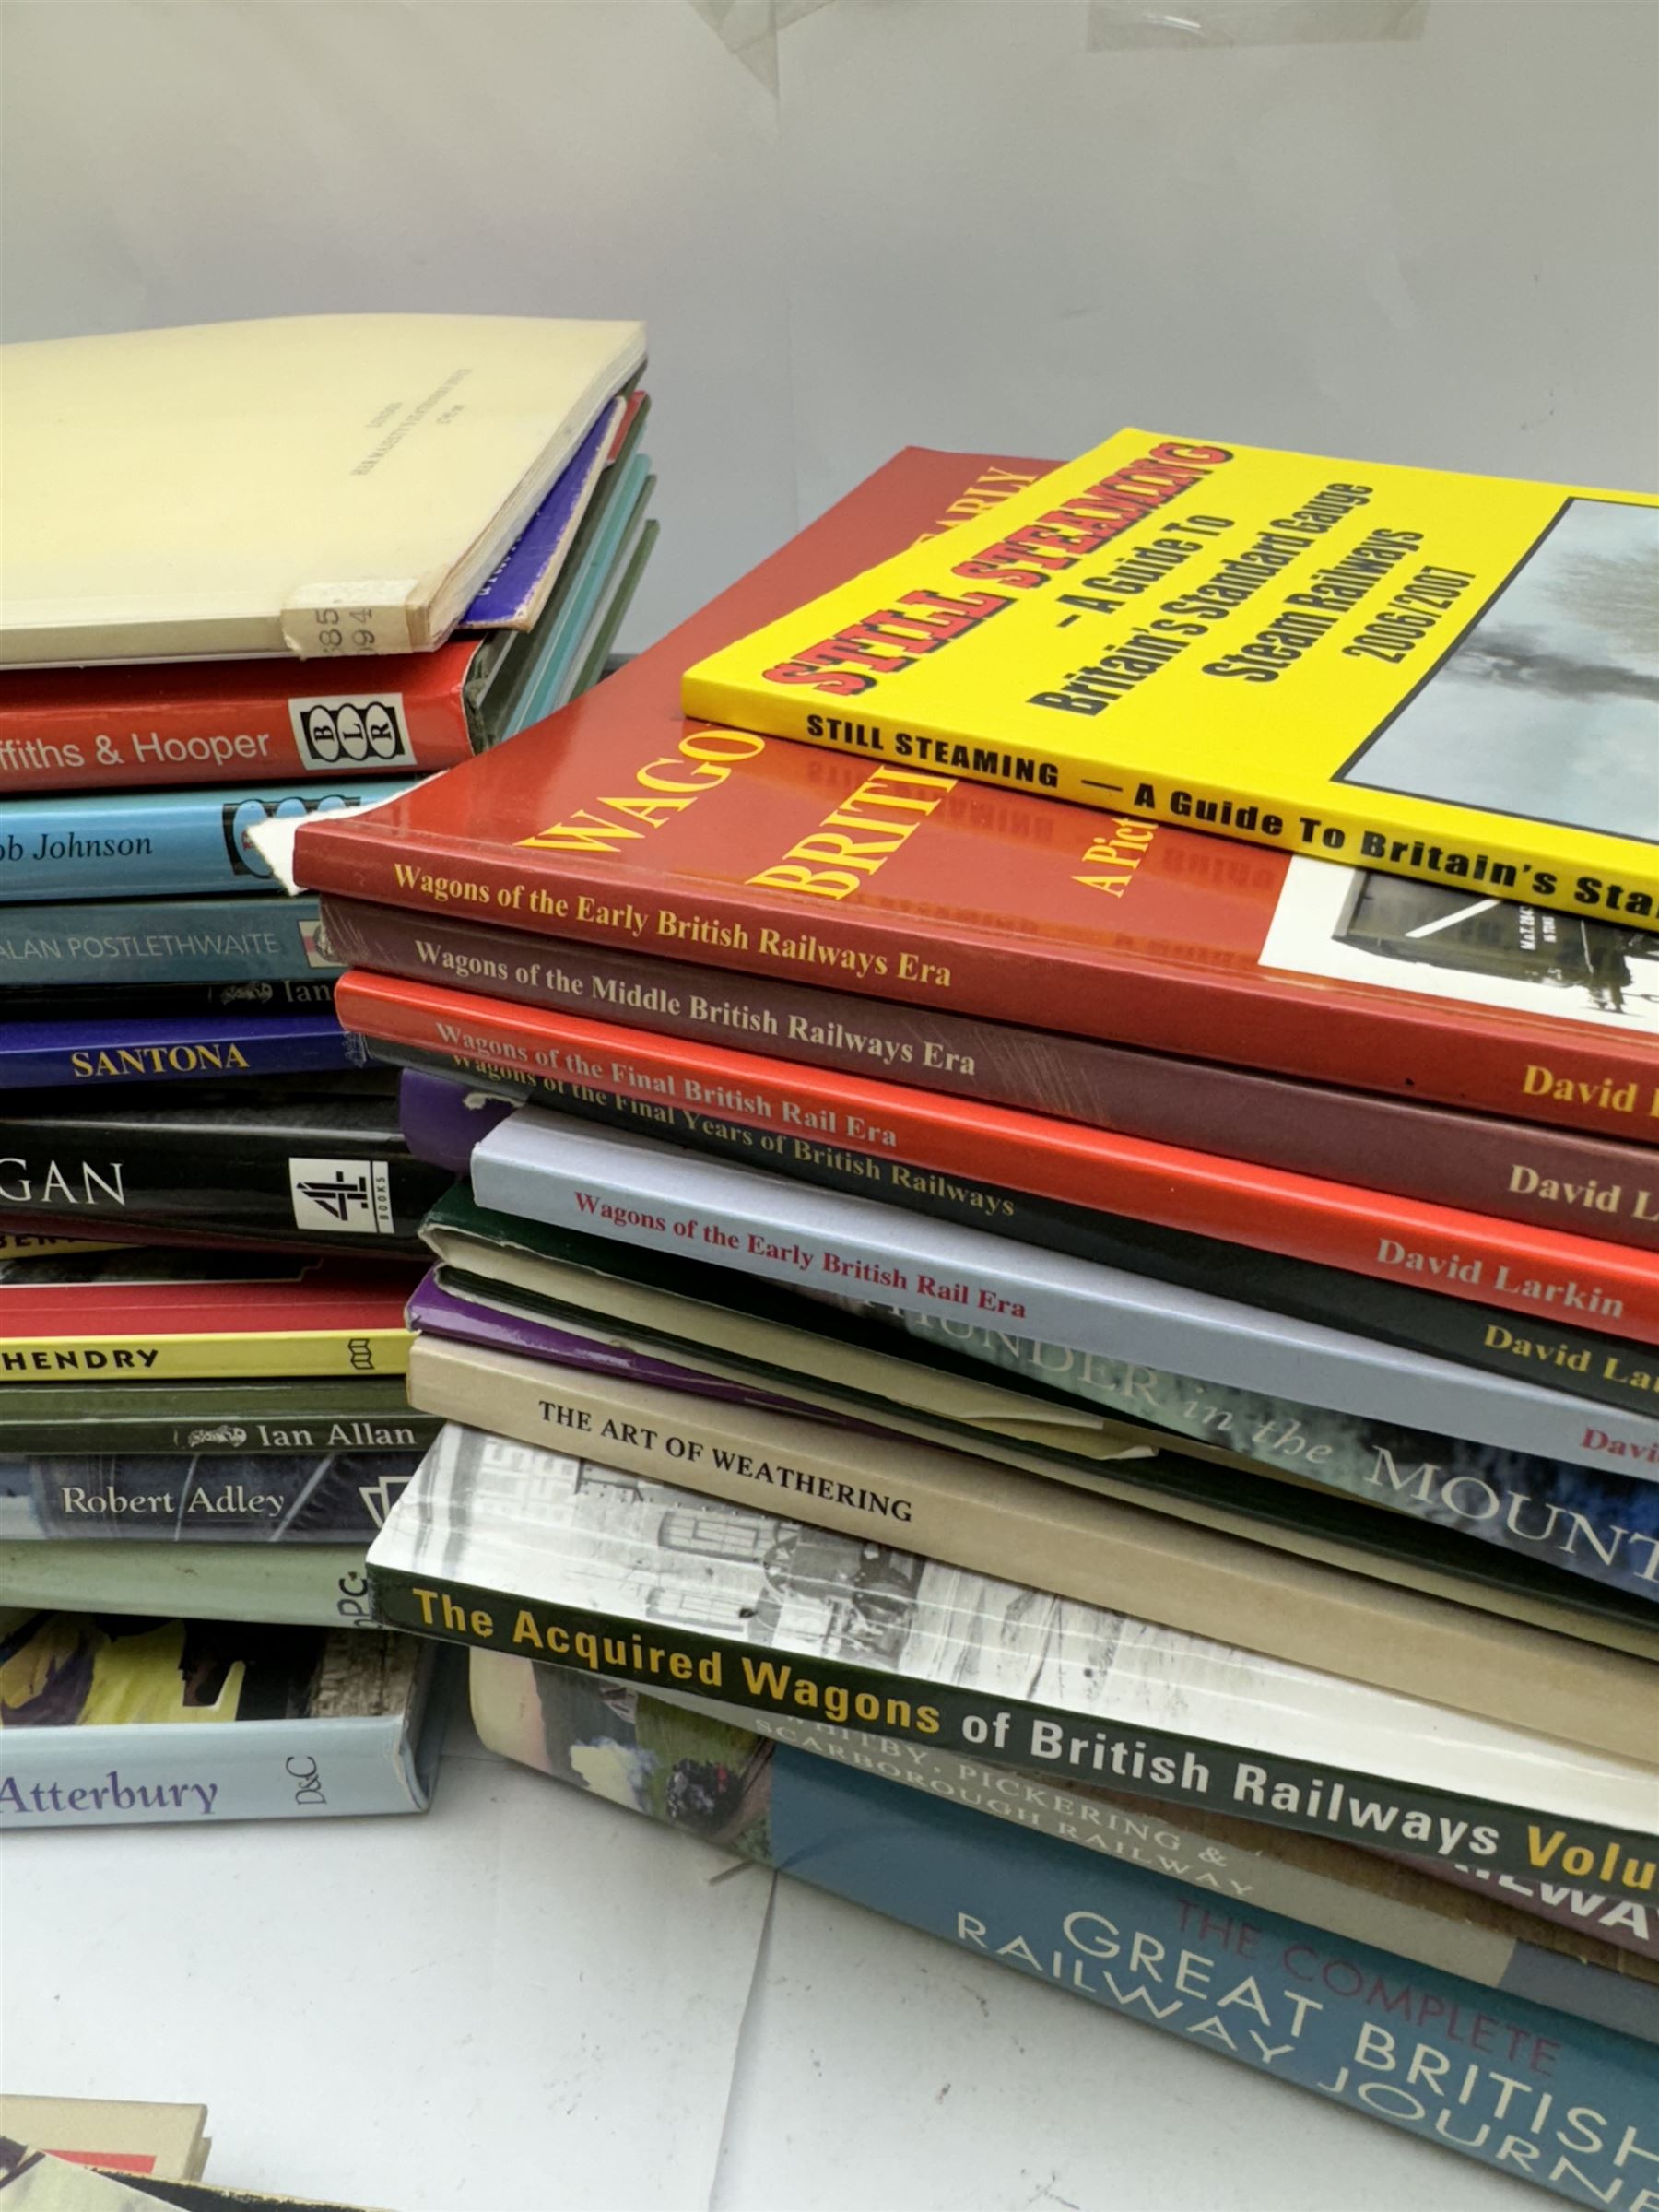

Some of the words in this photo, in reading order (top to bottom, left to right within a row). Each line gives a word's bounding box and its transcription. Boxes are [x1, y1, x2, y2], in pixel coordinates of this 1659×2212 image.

[1081, 537, 1204, 594] Guide
[1159, 515, 1236, 536] To
[762, 590, 1018, 695] STILL
[951, 442, 1233, 588] STEAMING
[1025, 618, 1209, 716] Britain's
[1159, 531, 1317, 619] Standard
[1269, 483, 1373, 535] Gauge
[1055, 594, 1126, 614] A
[1201, 610, 1339, 683] Steam
[1282, 528, 1425, 613] Railways
[1342, 566, 1477, 664] 2006/2007
[95, 735, 124, 765] &
[131, 732, 269, 766] Hooper
[513, 729, 766, 853] WAGO
[807, 714, 884, 750] STILL
[896, 733, 1060, 787] STEAMING
[1134, 783, 1156, 809] A
[1171, 787, 1284, 837] Guide
[1300, 817, 1346, 853] To
[1361, 830, 1558, 896] Britain's
[1574, 874, 1659, 920] Sta
[33, 831, 153, 861] Johnson
[1071, 875, 1132, 898] A
[0, 938, 62, 959] ALAN
[67, 933, 280, 959] POSTLETHWAITE
[394, 863, 490, 907] Wagons
[497, 885, 525, 910] of
[529, 893, 569, 918] the
[576, 896, 649, 937] Early
[658, 910, 749, 951] British
[759, 927, 888, 979] Railways
[897, 951, 952, 987] Era
[415, 938, 509, 982] Wagons
[515, 966, 541, 987] of
[546, 969, 585, 997] the
[591, 975, 682, 1016] Middle
[689, 994, 778, 1036] British
[787, 1015, 914, 1065] Railways
[922, 1040, 976, 1076] Era
[71, 1043, 250, 1077] SANTONA
[434, 1022, 528, 1061] Wagons
[535, 1048, 560, 1069] of
[565, 1054, 605, 1079] the
[611, 1061, 676, 1096] Final
[683, 1078, 772, 1119] British
[781, 1103, 837, 1136] Rail
[846, 1114, 897, 1148] Era
[1524, 1065, 1638, 1112] David
[453, 1054, 537, 1088] Wagons
[571, 1082, 607, 1106] the
[615, 1093, 675, 1126] Final
[683, 1112, 753, 1147] Years
[760, 1134, 787, 1157] of
[794, 1140, 880, 1182] British
[890, 1164, 1015, 1218] Railways
[0, 1157, 126, 1206] GAN
[1509, 1164, 1621, 1213] David
[574, 1193, 666, 1233] Wagons
[673, 1219, 700, 1241] of
[703, 1223, 740, 1250] the
[747, 1233, 814, 1271] Early
[823, 1253, 908, 1291] British
[916, 1274, 969, 1305] Rail
[977, 1292, 1026, 1320] Era
[1377, 1238, 1481, 1285] David
[1494, 1265, 1625, 1320] Larkin
[2, 1348, 159, 1371] HENDRY
[1484, 1324, 1592, 1372] David
[257, 1426, 312, 1446] Ian
[327, 1424, 416, 1445] Allan
[539, 1400, 593, 1431] THE
[600, 1419, 657, 1452] ART
[665, 1435, 703, 1463] OF
[712, 1448, 913, 1524] WEATHERING
[1183, 1384, 1231, 1432] in
[1253, 1413, 1333, 1465] the
[63, 1487, 175, 1513] Robert
[188, 1487, 285, 1517] Adley
[412, 1587, 494, 1638] The
[512, 1610, 723, 1688] Acquired
[742, 1655, 940, 1735] Wagons
[962, 1712, 1012, 1748] of
[1031, 1720, 1209, 1793] British
[1232, 1763, 1500, 1856] Railways
[0, 1771, 218, 1814] Atterbury
[286, 1756, 326, 1806] D&C
[755, 1718, 1040, 1826] SCARBOROUGH
[1059, 1821, 1254, 1896] RAILWAY
[959, 1764, 1181, 1851] PICKERING
[1198, 1846, 1228, 1867] &
[957, 1912, 1294, 2065] RAILWAY
[1177, 1899, 1260, 1959] THE
[1282, 1942, 1562, 2077] COMPLETE
[1064, 1911, 1322, 2039] GREAT
[1355, 2022, 1659, 2167] BRITISH
